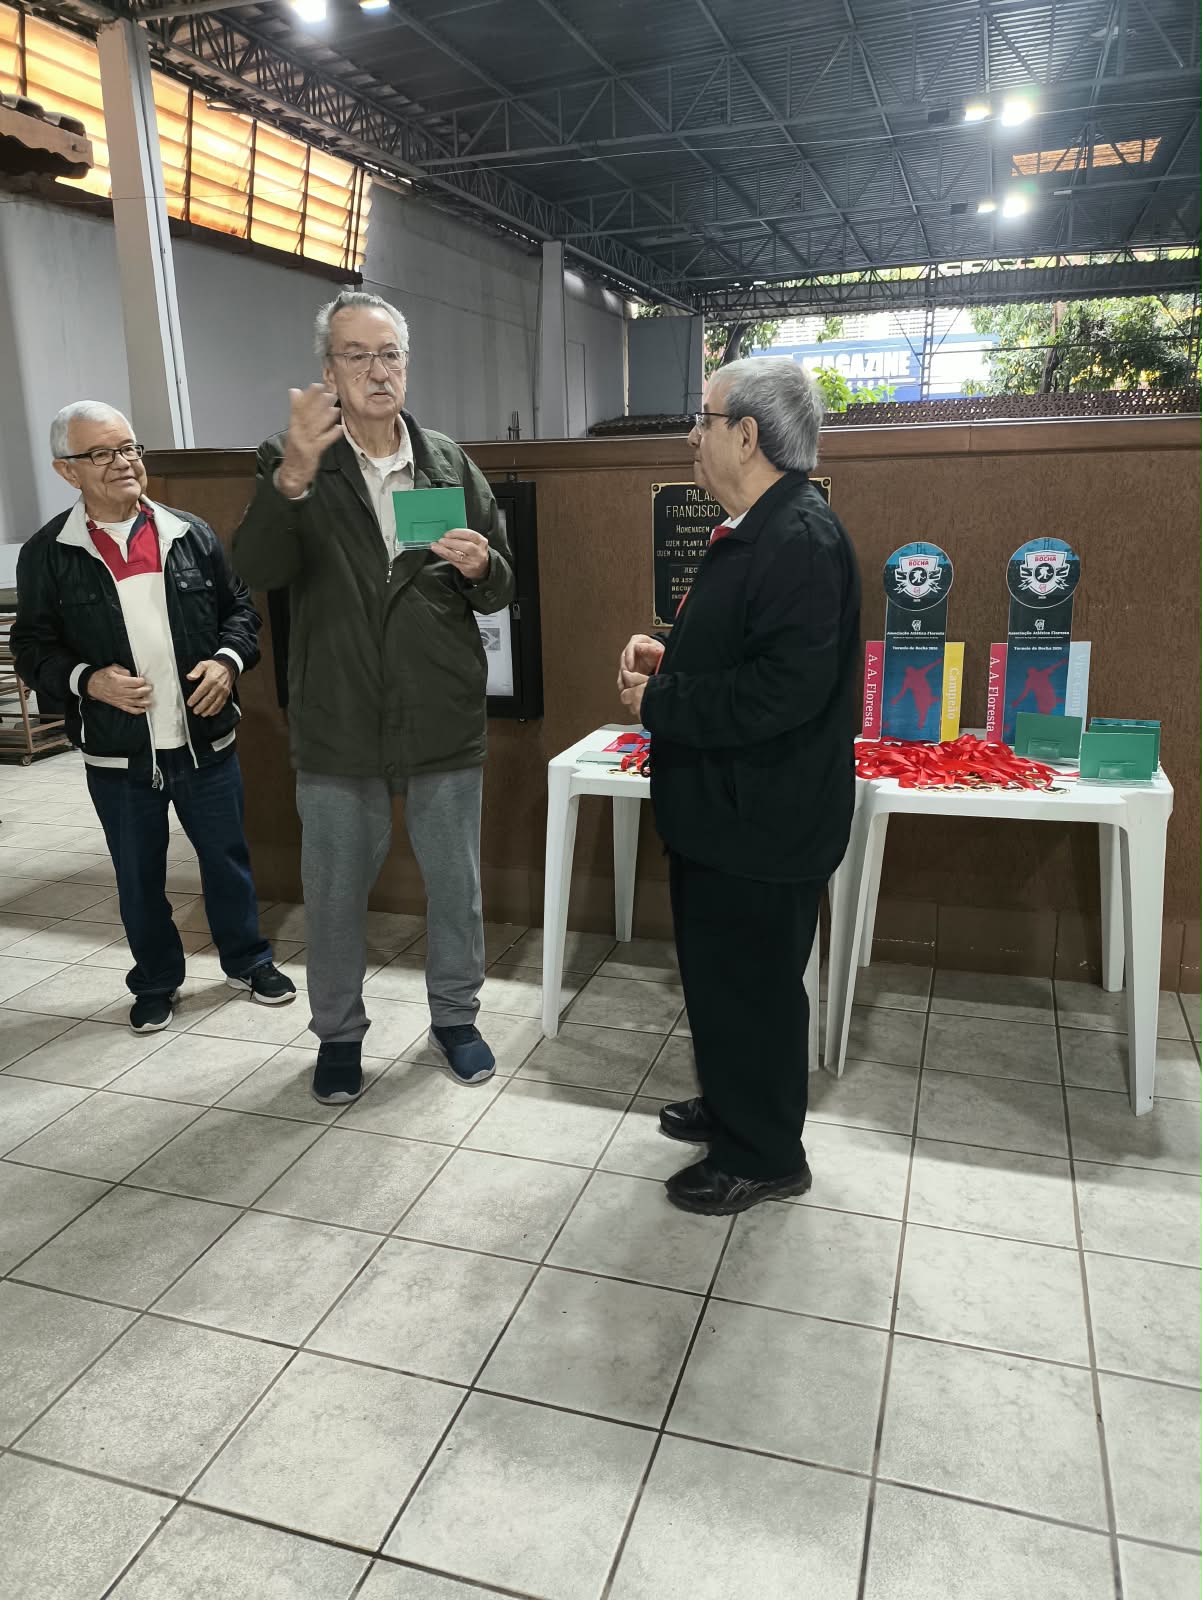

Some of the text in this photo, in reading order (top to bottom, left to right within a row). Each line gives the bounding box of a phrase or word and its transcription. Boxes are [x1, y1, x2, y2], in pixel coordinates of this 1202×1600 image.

[802, 350, 912, 380] MAGAZINE
[665, 504, 721, 518] FRANCISCO
[864, 653, 878, 728] A. A. Floresta
[946, 667, 960, 720] Campeão
[986, 656, 1001, 732] A. A. Floresta
